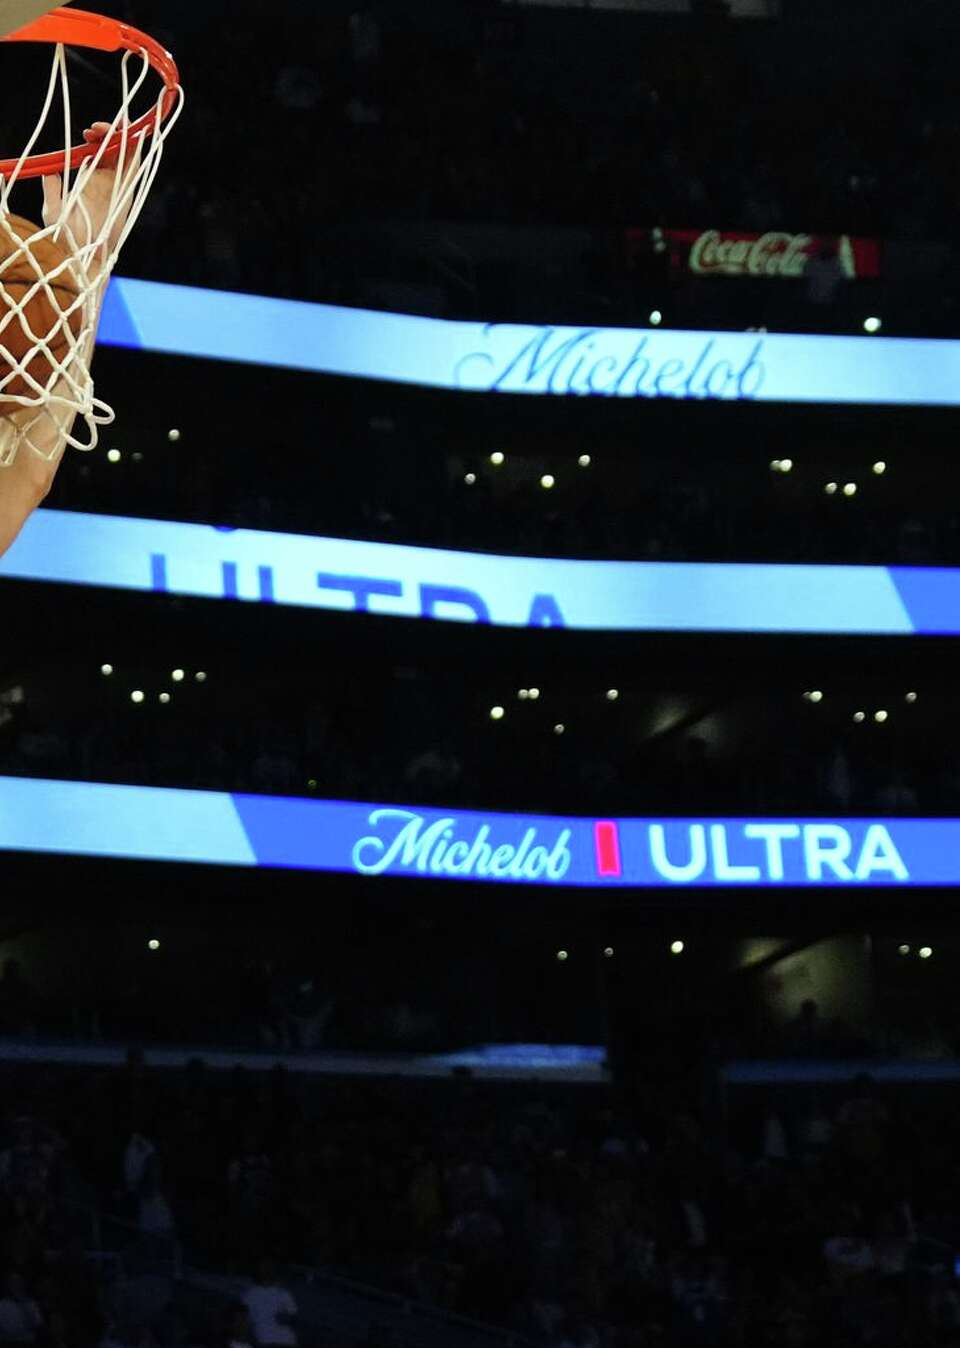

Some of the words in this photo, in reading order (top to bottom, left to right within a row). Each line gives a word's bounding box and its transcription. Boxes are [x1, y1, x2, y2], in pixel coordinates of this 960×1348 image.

[453, 322, 765, 398] Michelob
[352, 808, 571, 876] Michelob
[649, 823, 909, 881] ULTRA
